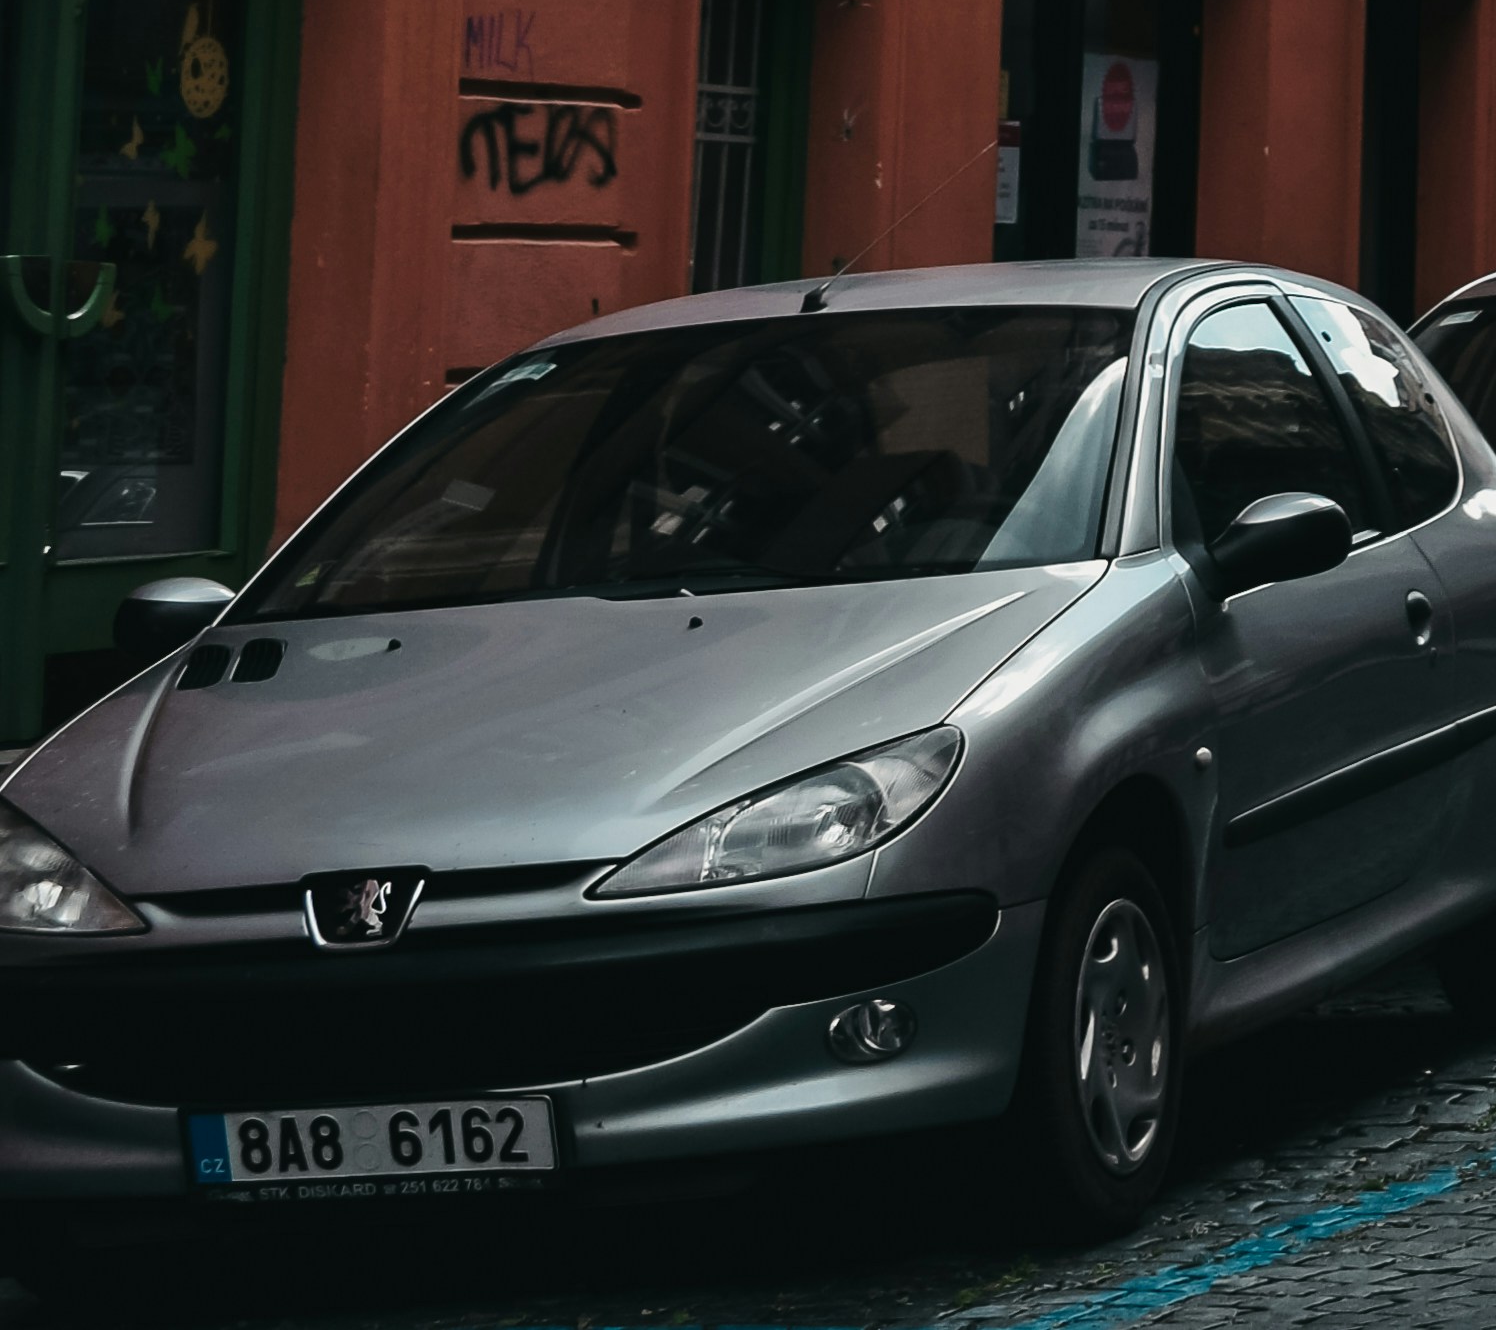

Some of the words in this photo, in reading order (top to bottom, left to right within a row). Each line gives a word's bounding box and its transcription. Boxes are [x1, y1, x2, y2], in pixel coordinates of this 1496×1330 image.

[464, 9, 536, 79] MILK
[238, 1113, 344, 1174] 8A8
[388, 1105, 530, 1167] 6162
[200, 1158, 226, 1174] CZ
[401, 1181, 427, 1195] 251
[434, 1179, 459, 1193] 622
